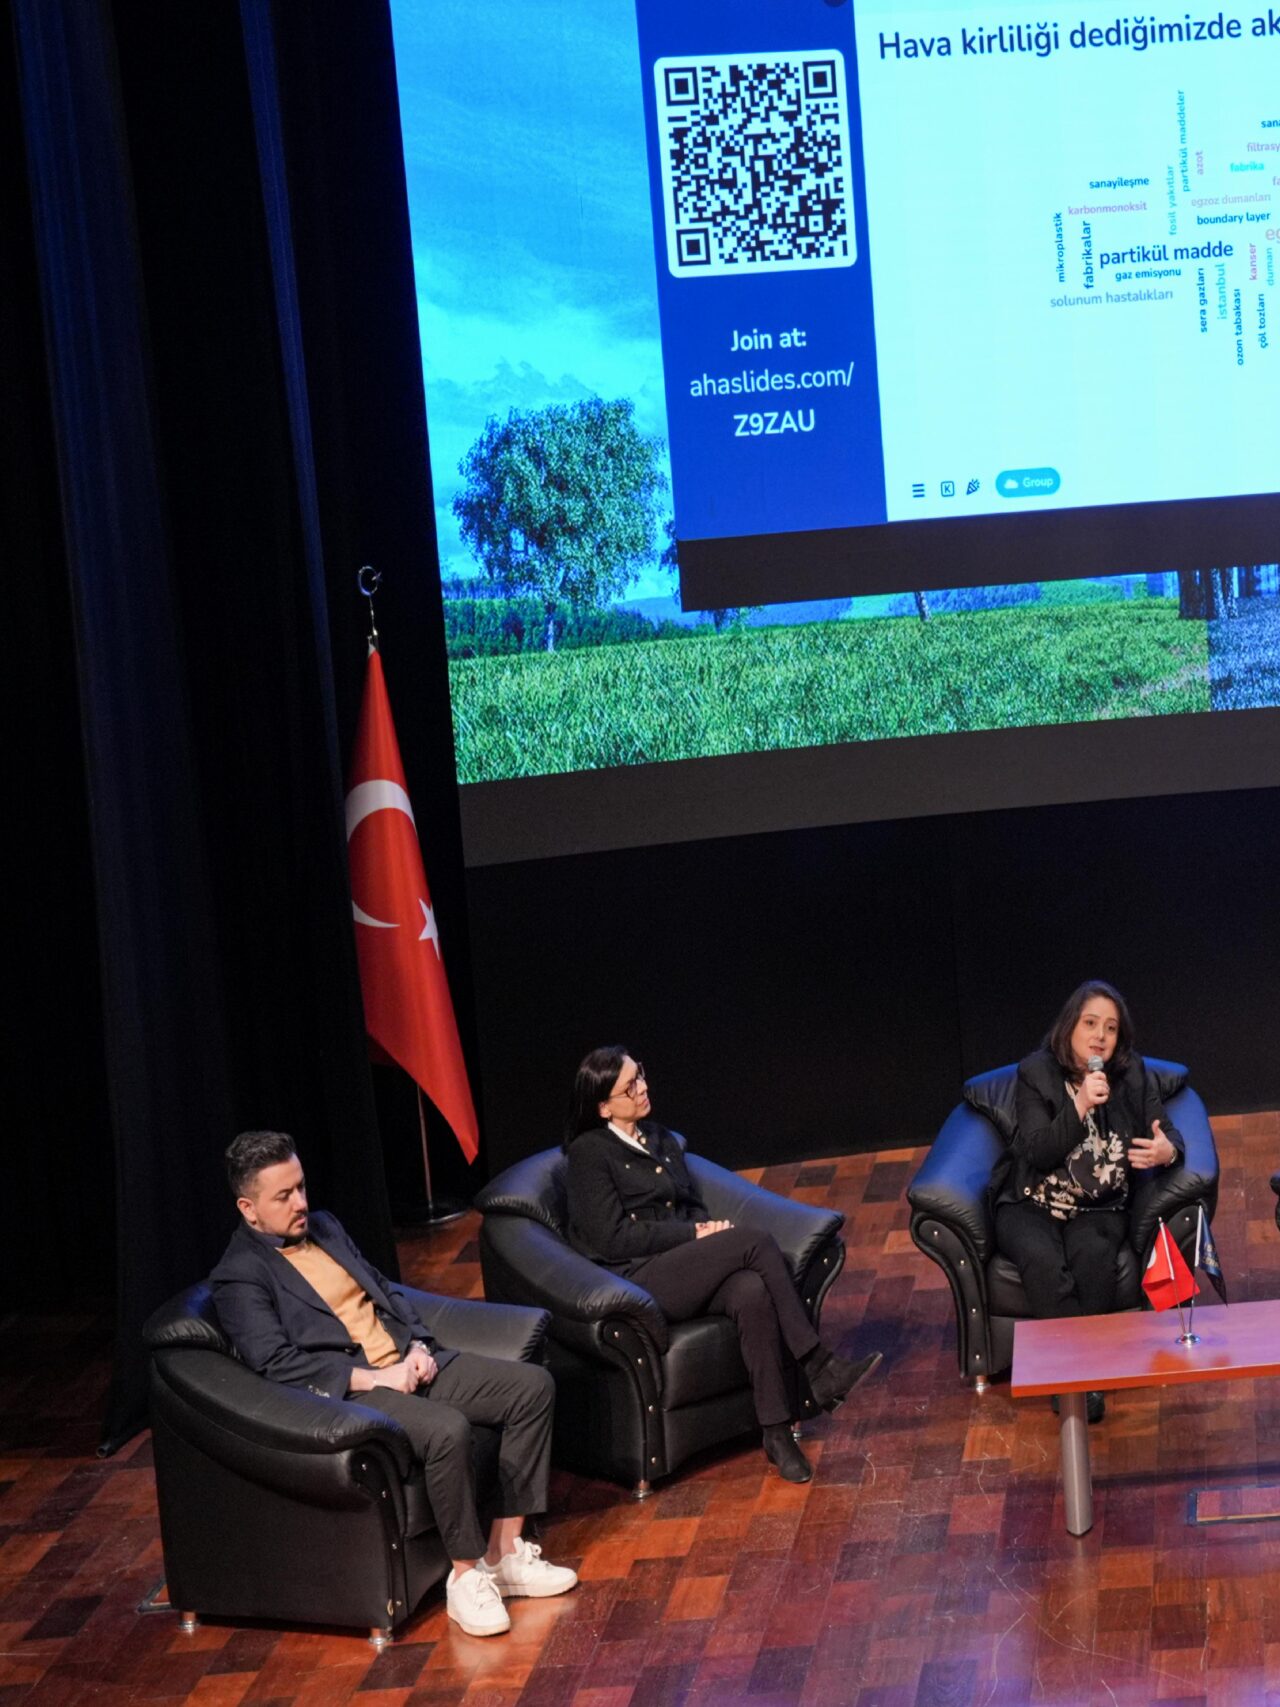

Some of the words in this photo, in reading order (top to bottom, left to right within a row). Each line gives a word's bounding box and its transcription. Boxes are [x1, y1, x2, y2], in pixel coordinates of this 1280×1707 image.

[879, 31, 952, 59] Hava
[961, 22, 1060, 57] kirliliği
[1069, 12, 1242, 51] dediğimizde
[1177, 90, 1187, 144] maddeler
[1179, 147, 1191, 192] partikül
[1196, 150, 1204, 175] azot
[1230, 161, 1265, 172] fabrika
[1089, 177, 1150, 189] sanayileşme
[1068, 201, 1147, 215] karbonmonoksit
[1192, 197, 1220, 208] egzoz
[1221, 193, 1271, 204] dumanları
[1168, 211, 1177, 236] fosil
[1197, 214, 1243, 225] boundary
[1246, 212, 1271, 223] layer
[1053, 212, 1065, 283] mikroplastik
[1081, 221, 1094, 289] fabrikalar
[1100, 244, 1169, 269] partikül
[1174, 240, 1233, 260] madde
[1249, 243, 1257, 280] kanser
[1115, 271, 1133, 282] gaz
[1135, 268, 1181, 279] emisyonu
[1266, 247, 1274, 286] duman
[1050, 295, 1102, 308] solunum
[1105, 288, 1173, 303] hastalıkları
[1197, 268, 1208, 306] gazları
[1215, 263, 1227, 320] istanbul
[1200, 309, 1208, 333] sera
[1233, 289, 1242, 336] tabakası
[1257, 294, 1266, 329] tozları
[731, 328, 772, 352] Join
[779, 328, 807, 348] at:
[1258, 332, 1268, 348] çöl
[690, 361, 854, 397] ahaslides.com/
[733, 409, 816, 437] Z9ZAU
[1023, 476, 1053, 488] Group
